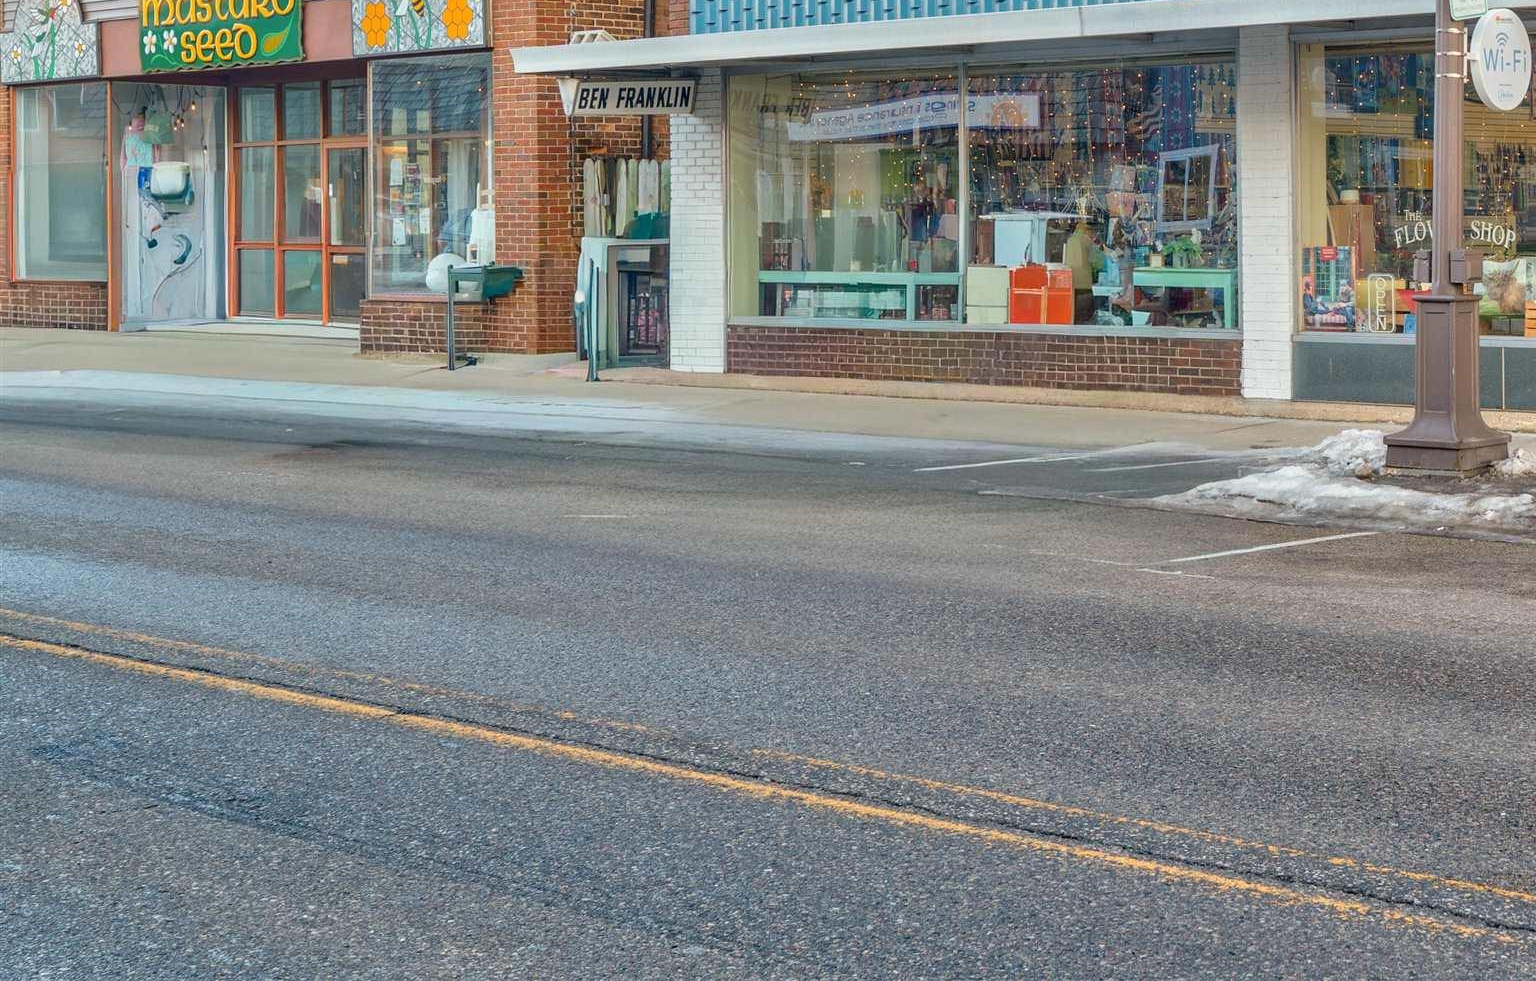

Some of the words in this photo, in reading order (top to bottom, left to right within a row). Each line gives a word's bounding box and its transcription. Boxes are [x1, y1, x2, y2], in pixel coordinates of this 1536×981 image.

[1483, 46, 1527, 73] Wi-Fi
[578, 86, 610, 110] BEN
[616, 85, 691, 109] FRANKLIN
[1470, 220, 1516, 249] SHOP
[1375, 277, 1387, 330] OPEN
